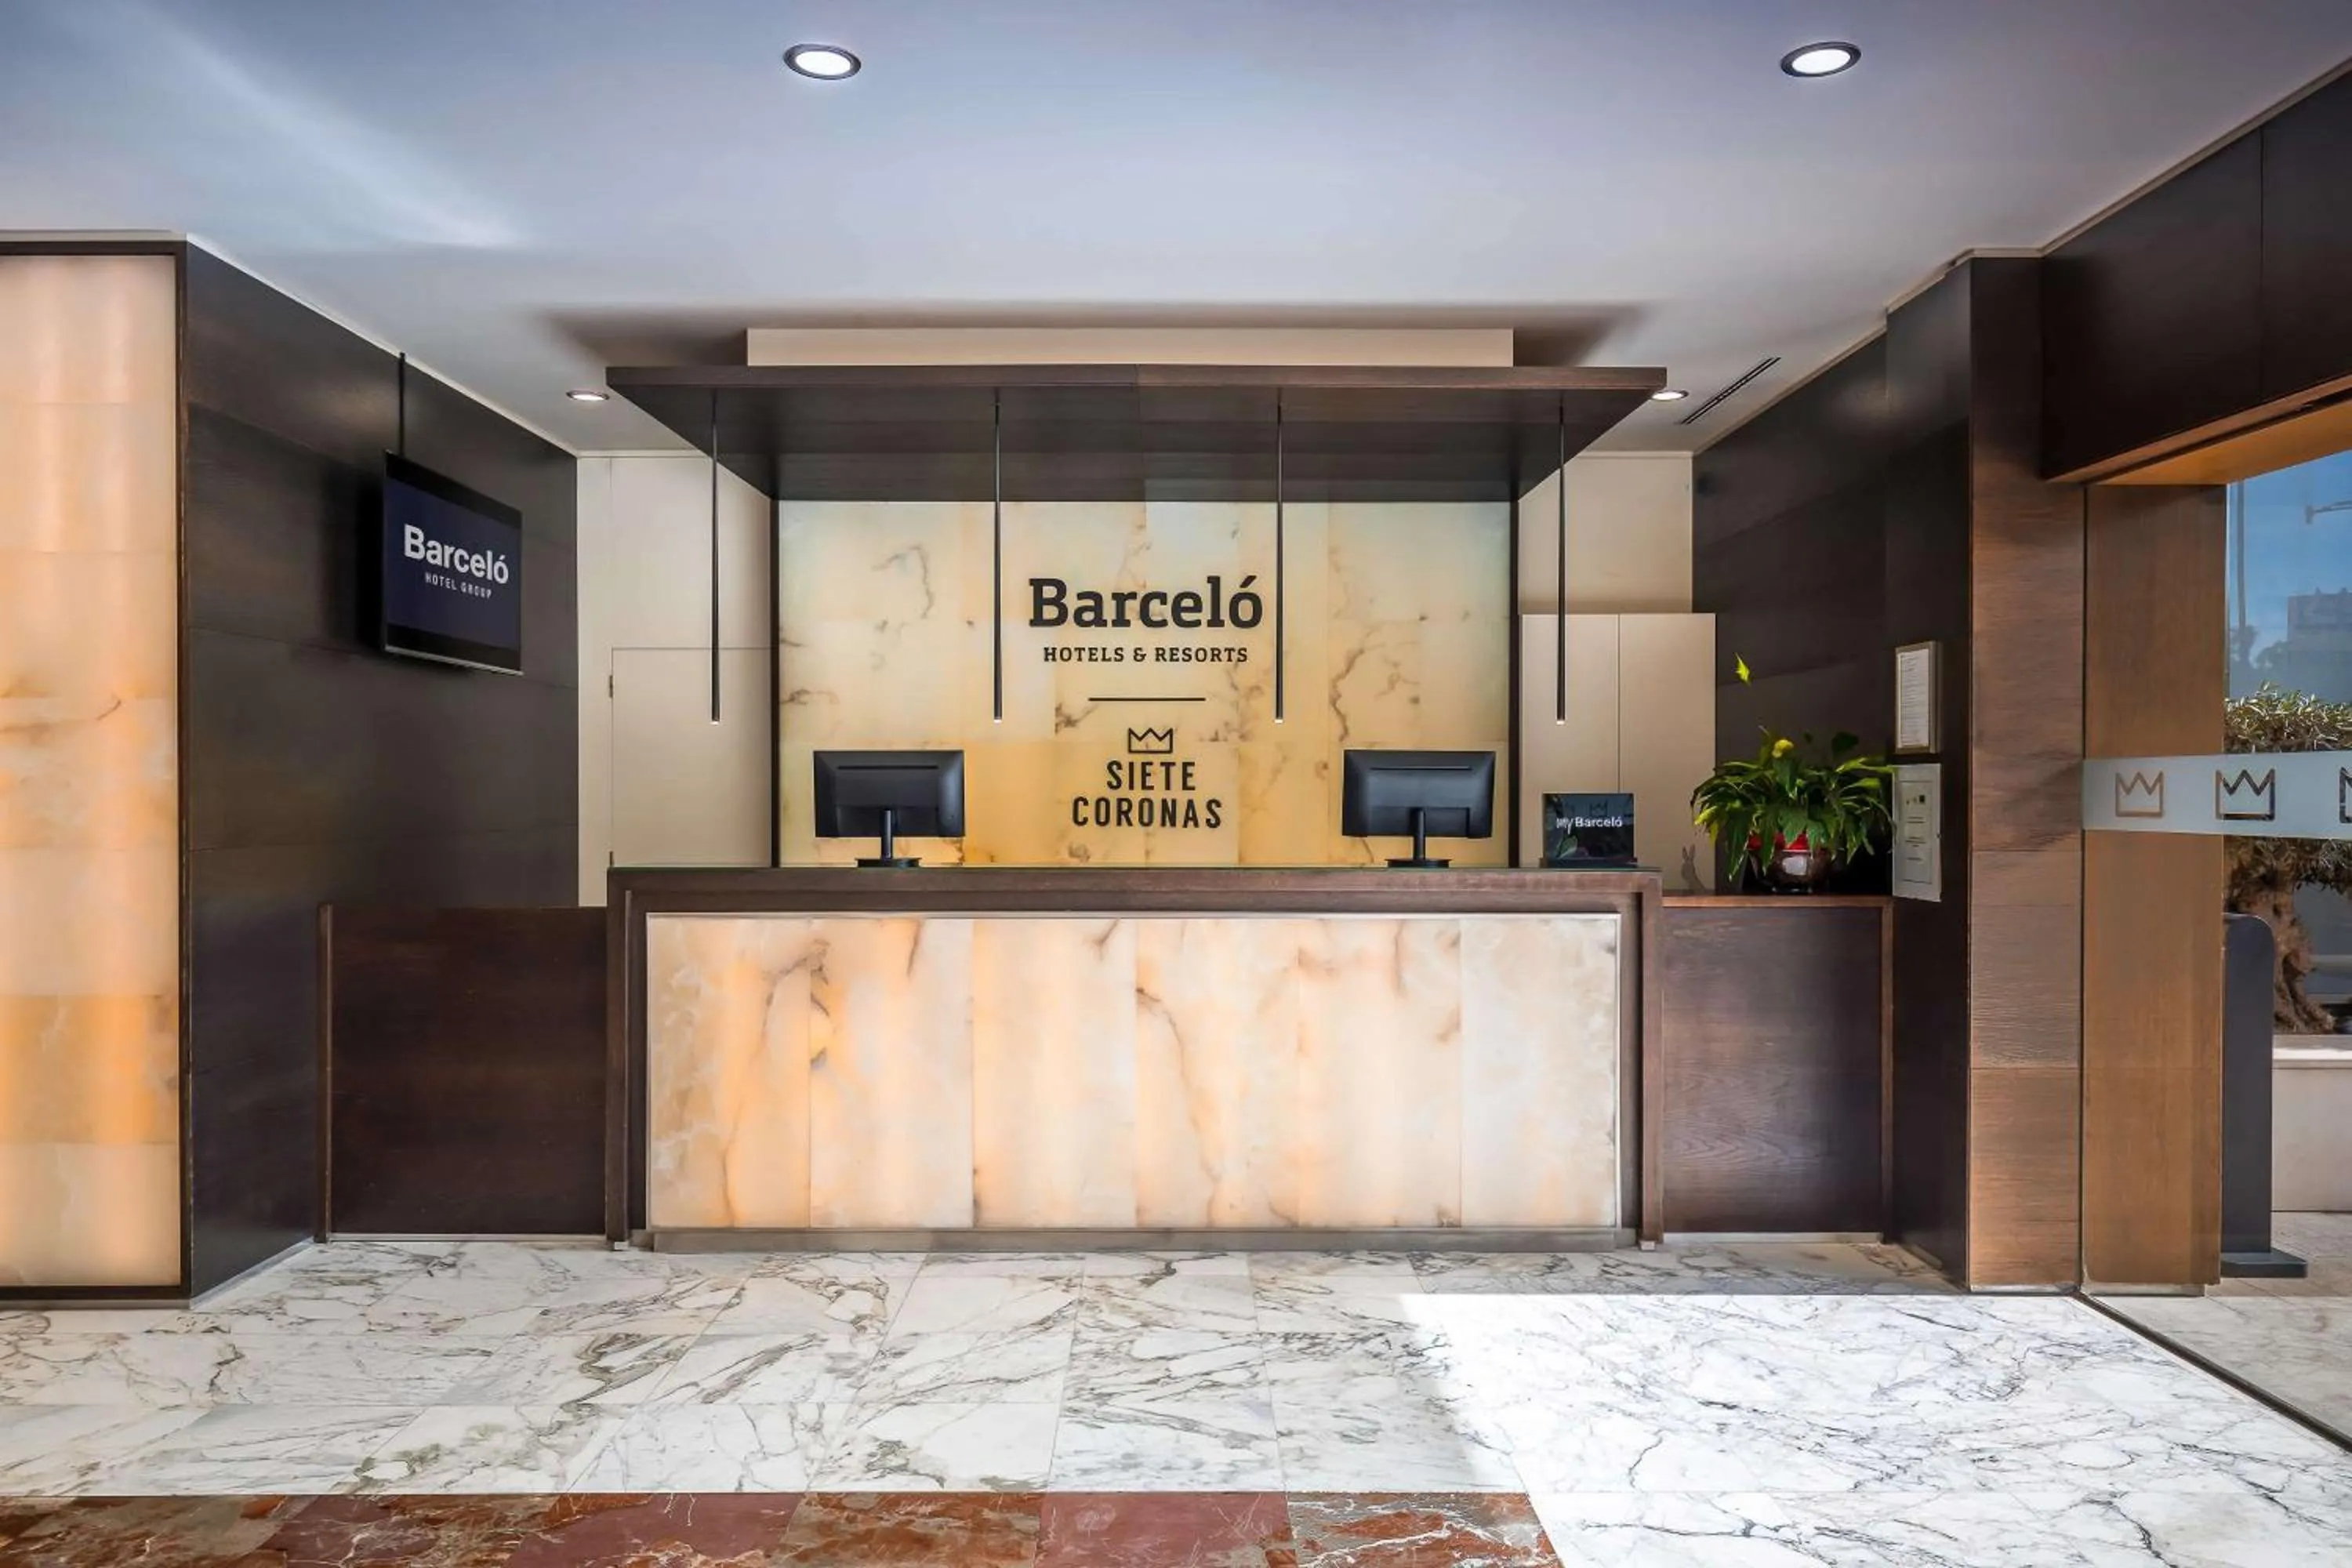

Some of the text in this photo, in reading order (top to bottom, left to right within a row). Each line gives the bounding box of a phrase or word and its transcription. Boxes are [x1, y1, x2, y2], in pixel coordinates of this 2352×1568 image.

[404, 523, 509, 584] Barceló
[425, 572, 457, 590] HOTEL
[1029, 575, 1263, 628] Barceló
[1044, 647, 1248, 662] HOTELS & RESORTS
[1106, 760, 1196, 791] SIETE
[1073, 797, 1222, 828] CORONAS
[1575, 816, 1622, 827] Barceló
